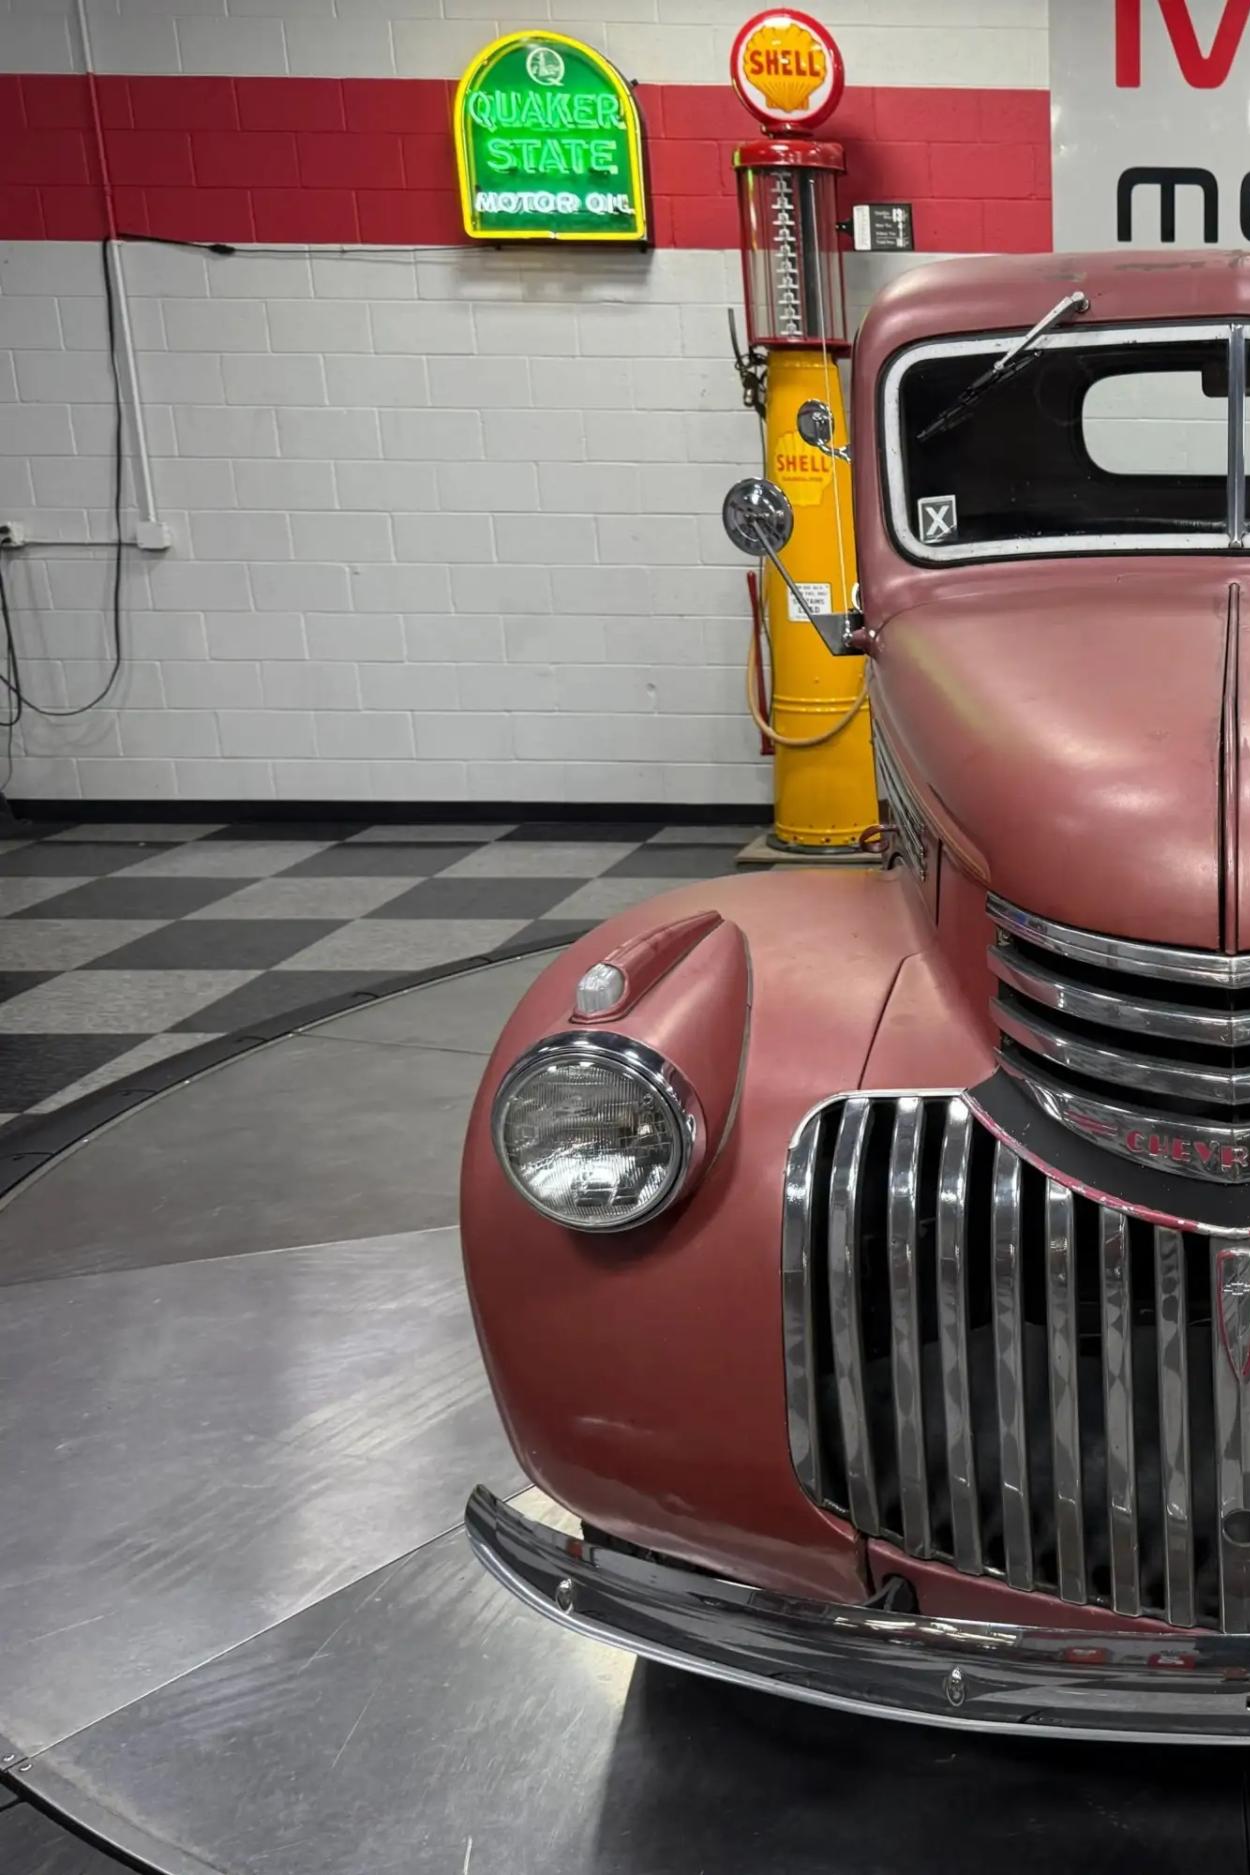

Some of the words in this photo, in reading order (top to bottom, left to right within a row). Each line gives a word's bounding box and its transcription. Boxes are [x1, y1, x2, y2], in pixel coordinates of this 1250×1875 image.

[749, 49, 821, 79] SHELL
[468, 89, 627, 133] QUAKER
[487, 138, 619, 174] STATE
[475, 191, 581, 213] MOTOR
[585, 192, 636, 214] OIL
[776, 453, 830, 472] SHELL
